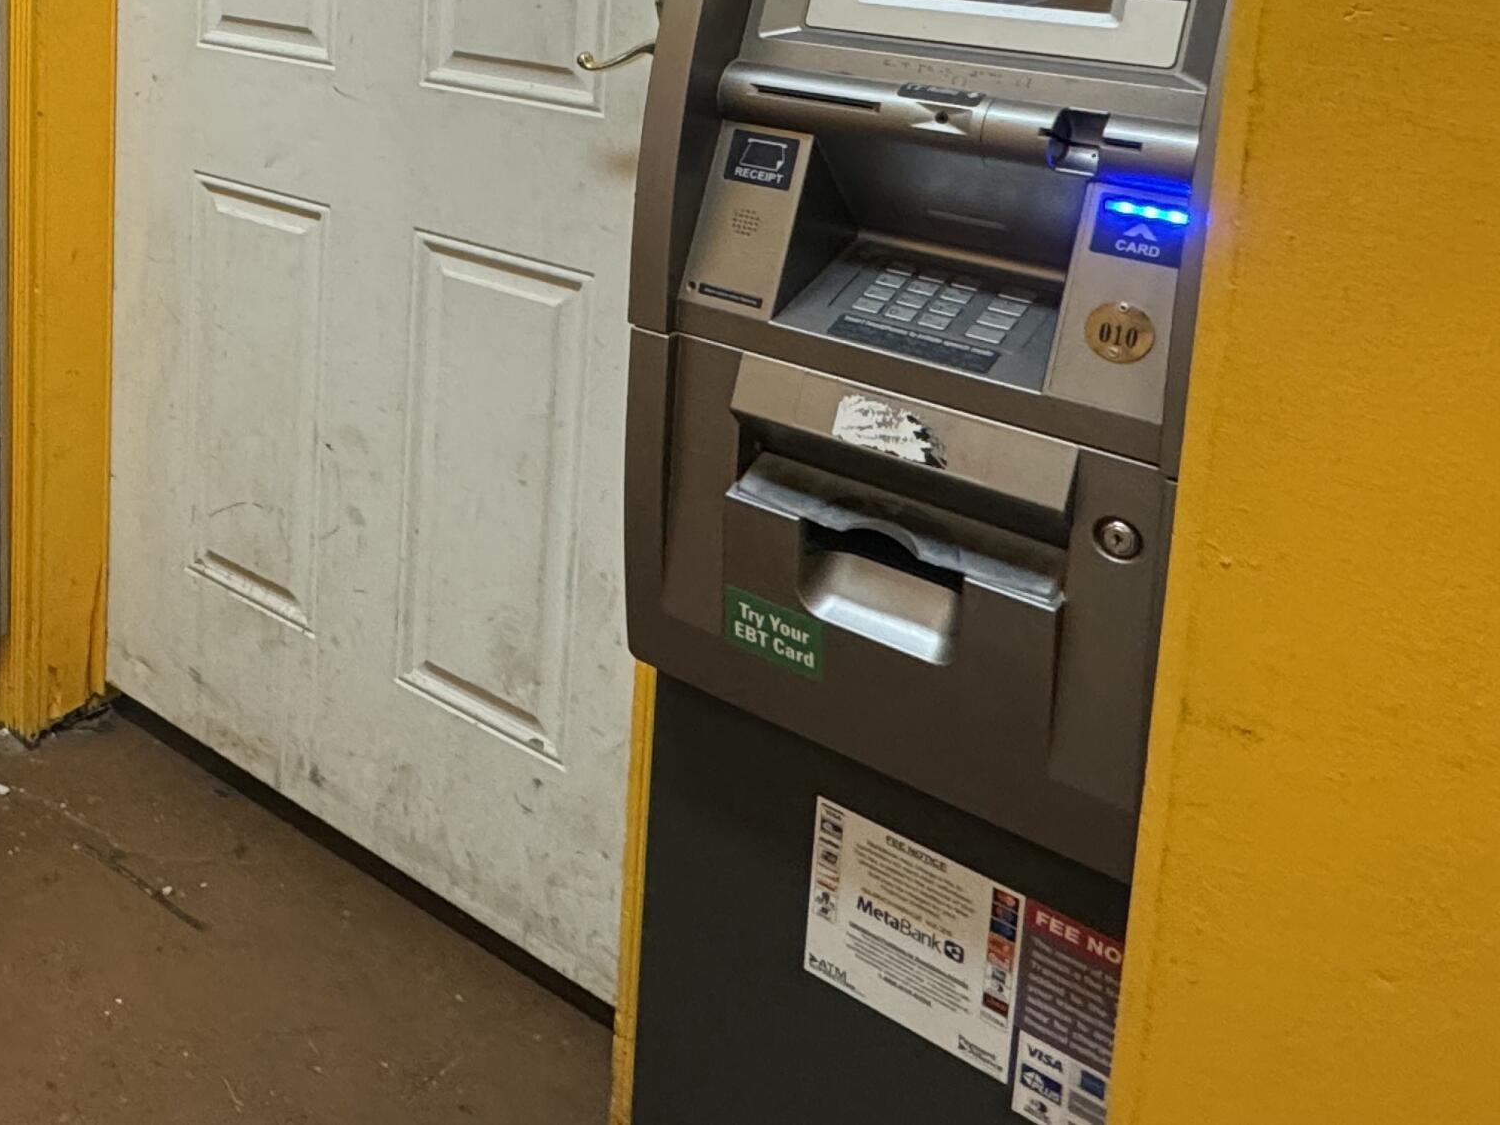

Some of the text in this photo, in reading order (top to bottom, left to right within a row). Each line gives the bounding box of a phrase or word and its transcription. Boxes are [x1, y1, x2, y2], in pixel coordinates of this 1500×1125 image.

[734, 166, 784, 184] RECEIPT
[1115, 239, 1160, 258] CARD
[1099, 322, 1138, 349] 010
[738, 601, 810, 644] Try Your
[734, 620, 815, 669] EBT Card
[856, 895, 942, 955] MetaBank
[1035, 910, 1082, 945] FEE
[1026, 1044, 1064, 1073] VISA
